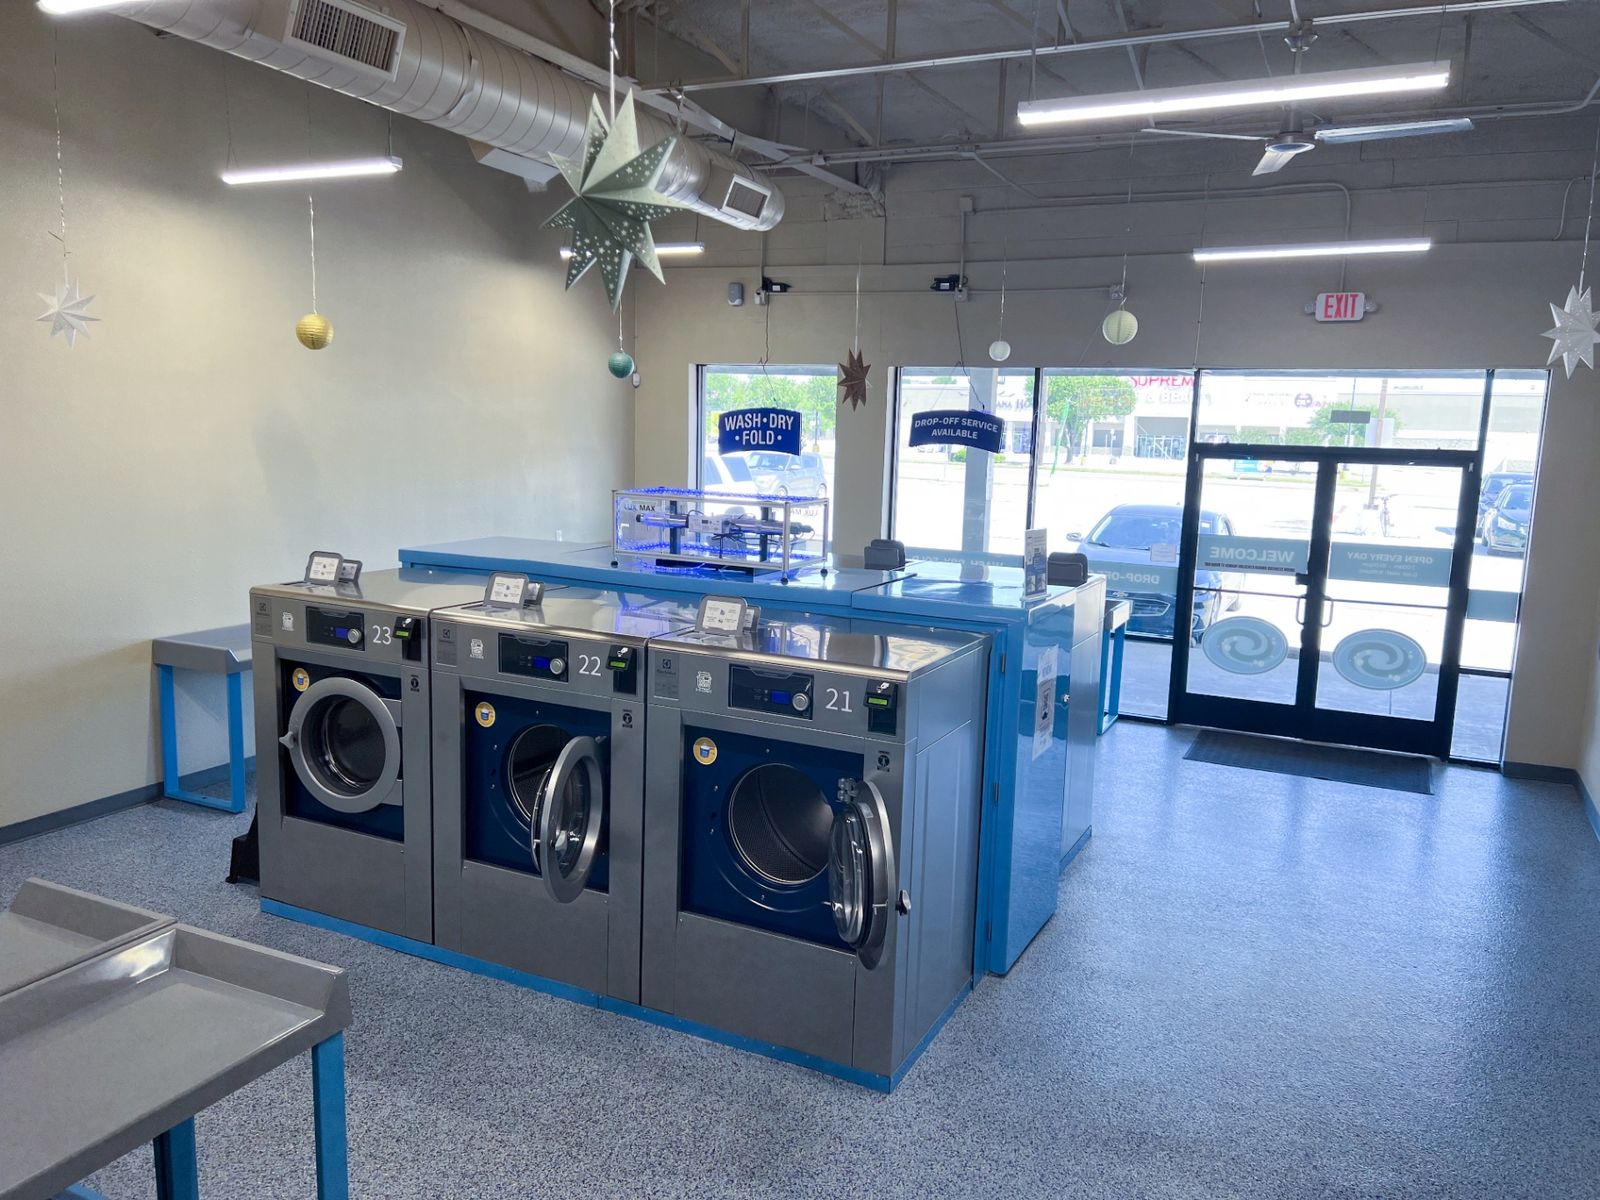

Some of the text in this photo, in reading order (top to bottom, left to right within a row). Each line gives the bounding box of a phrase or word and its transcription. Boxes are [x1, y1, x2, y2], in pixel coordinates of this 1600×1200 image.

[1324, 294, 1359, 319] EXIT
[725, 412, 794, 431] WASH DRY
[914, 417, 999, 433] DROP-OFF SERVICE
[742, 429, 774, 445] FOLD
[931, 428, 978, 439] AVAILABLE
[639, 504, 656, 513] MAX
[372, 625, 392, 645] 23
[578, 654, 602, 677] 22
[824, 687, 853, 713] 21
